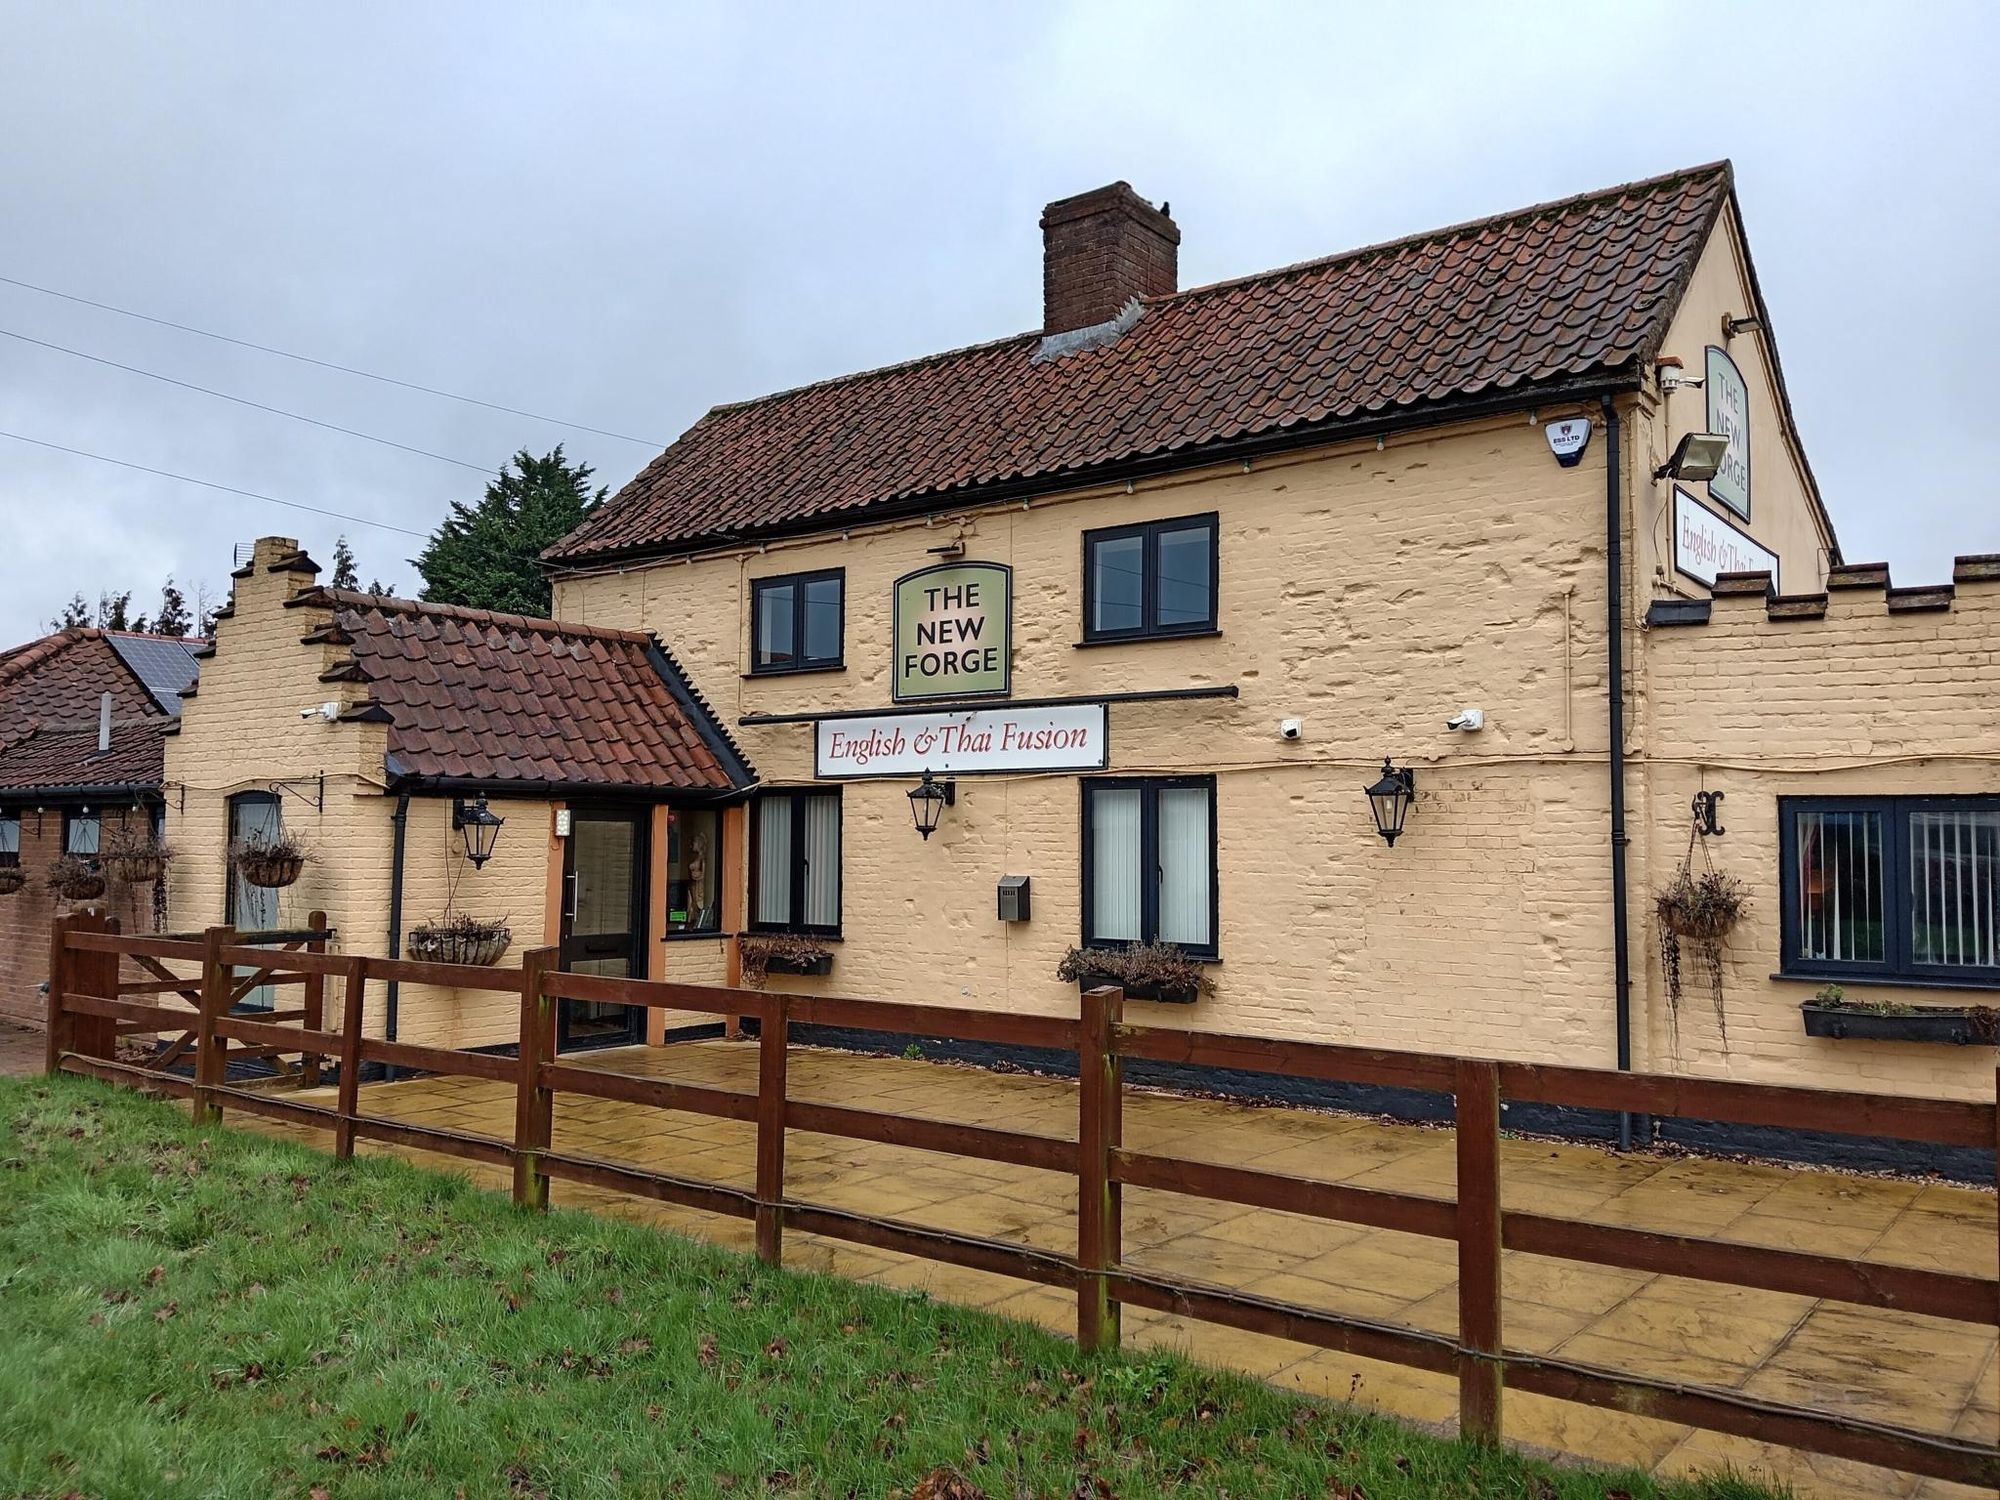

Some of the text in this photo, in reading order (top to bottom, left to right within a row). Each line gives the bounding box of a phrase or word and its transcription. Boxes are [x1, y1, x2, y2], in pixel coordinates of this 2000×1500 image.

[1718, 371, 1739, 415] THE
[1716, 407, 1741, 451] NEW
[1719, 450, 1746, 492] ORGE
[1682, 514, 1717, 566] English
[1718, 538, 1729, 570] &
[923, 582, 980, 612] THE
[916, 615, 986, 646] NEW
[904, 647, 998, 678] FORGE
[828, 721, 1088, 765] English & Thai Fusion
